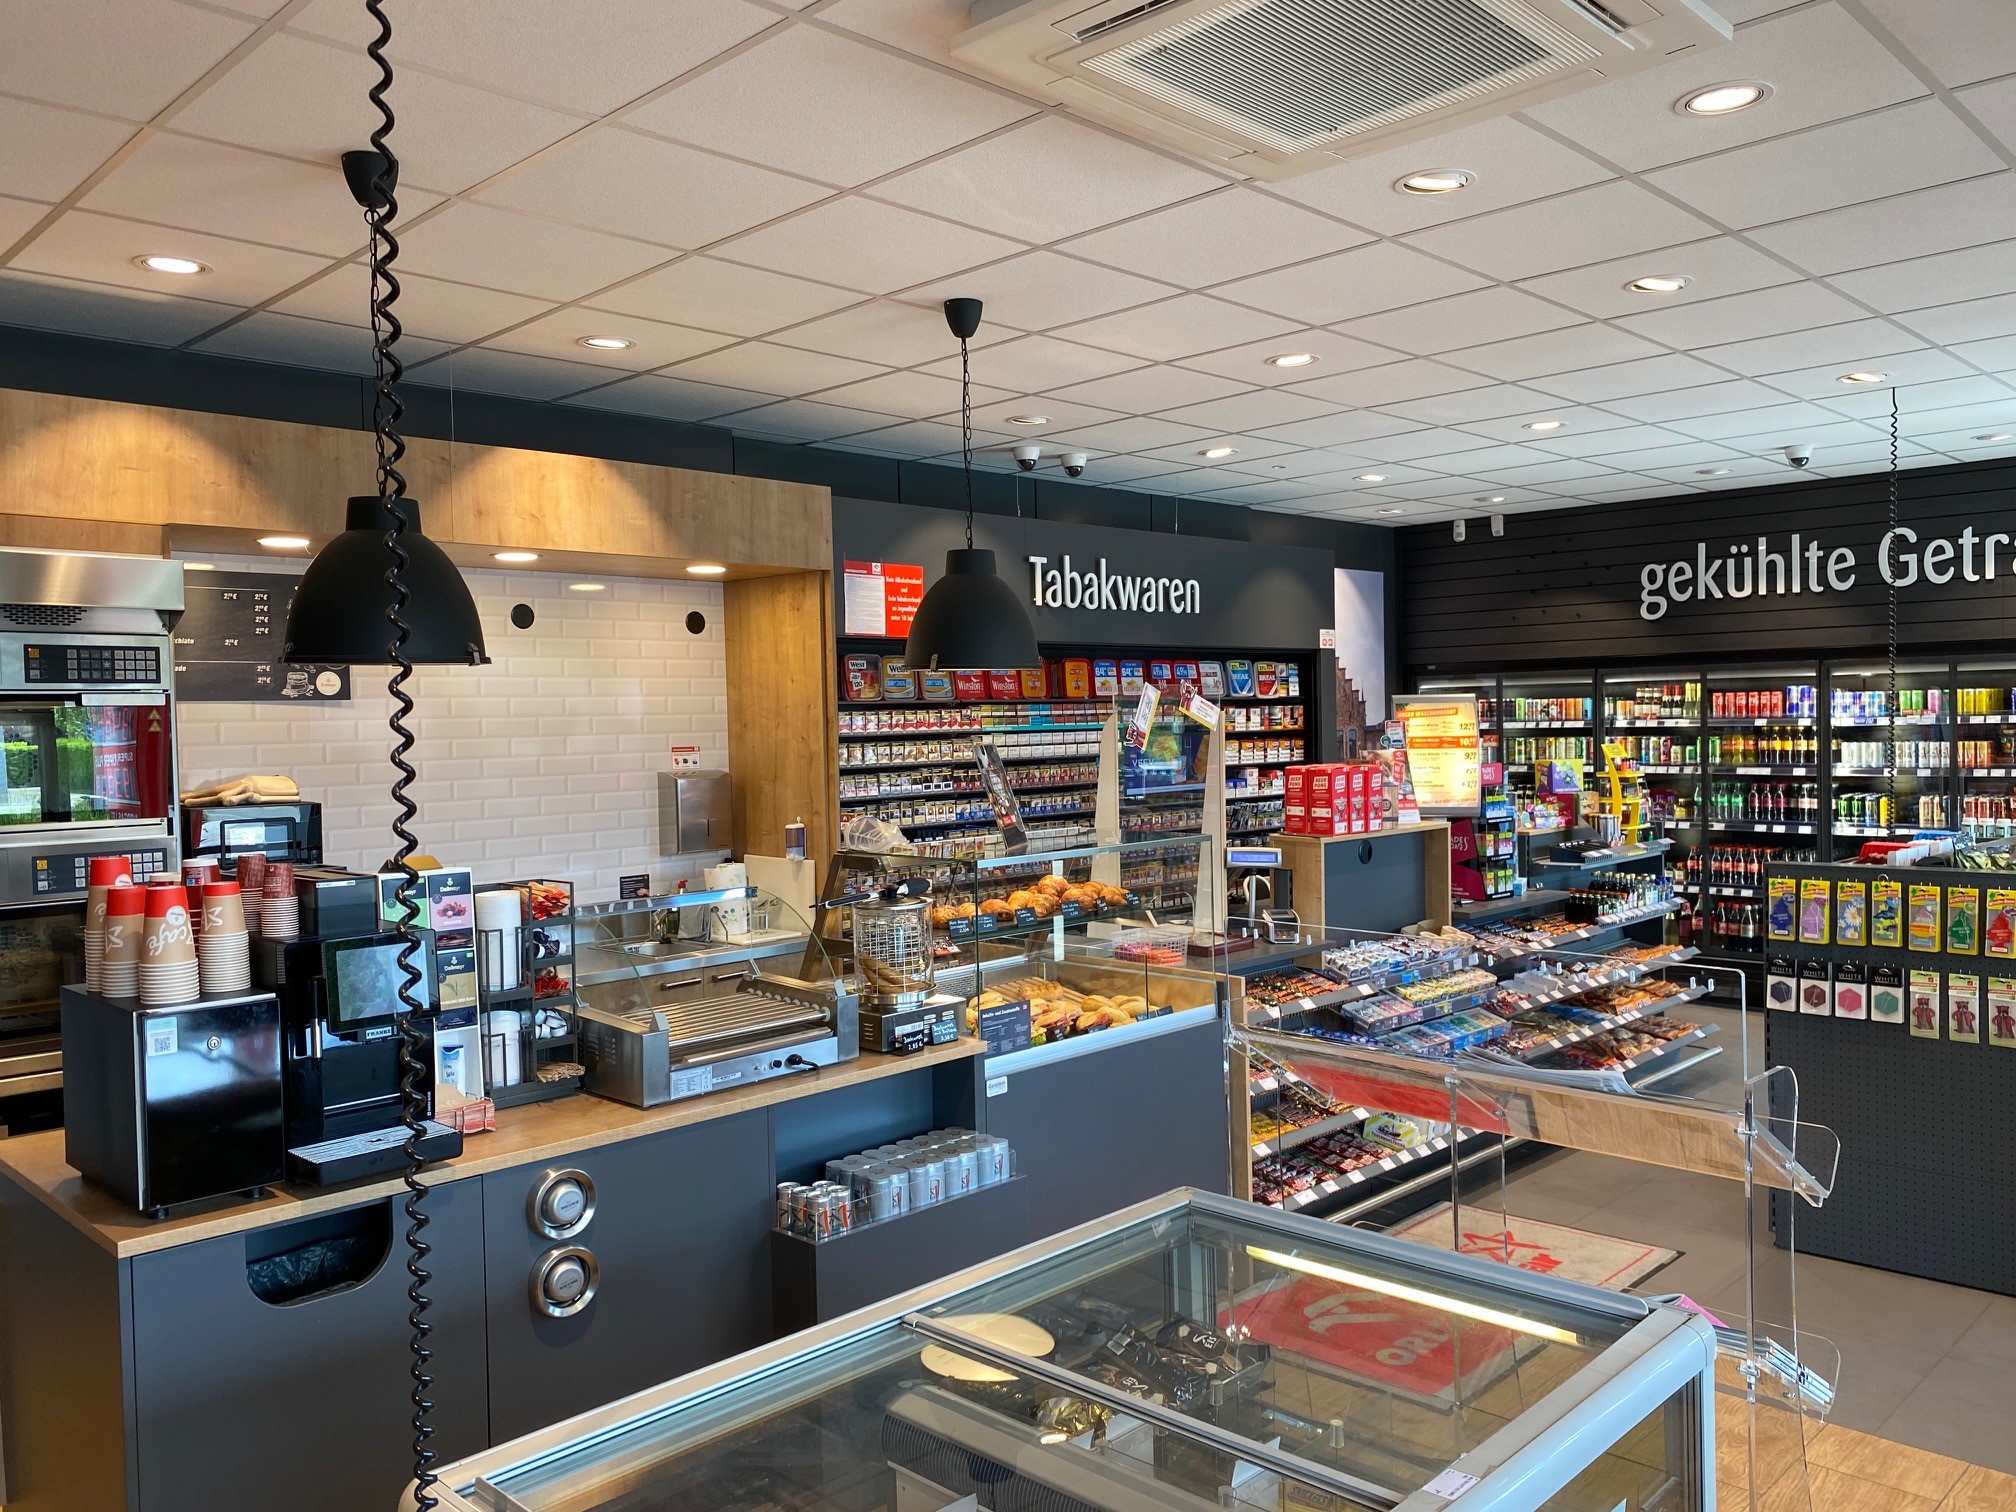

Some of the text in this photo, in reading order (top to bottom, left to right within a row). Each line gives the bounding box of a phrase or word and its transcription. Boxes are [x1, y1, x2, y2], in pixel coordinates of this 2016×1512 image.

[1640, 526, 2016, 620] gekühlte Getr
[1029, 554, 1200, 614] Tabakwaren
[958, 680, 982, 691] Winston
[991, 680, 1015, 691] Winston
[1397, 710, 1415, 718] UNSER
[439, 884, 461, 893] Dallmayr
[146, 922, 193, 955] café
[444, 963, 465, 972] Dallmayr
[1770, 965, 1793, 974] WHITE
[1802, 969, 1826, 978] WHITE
[1838, 972, 1862, 980] WHITE
[1874, 975, 1899, 984] WHITE
[366, 1027, 391, 1037] FRANKE
[1204, 1335, 1219, 1350] EIS
